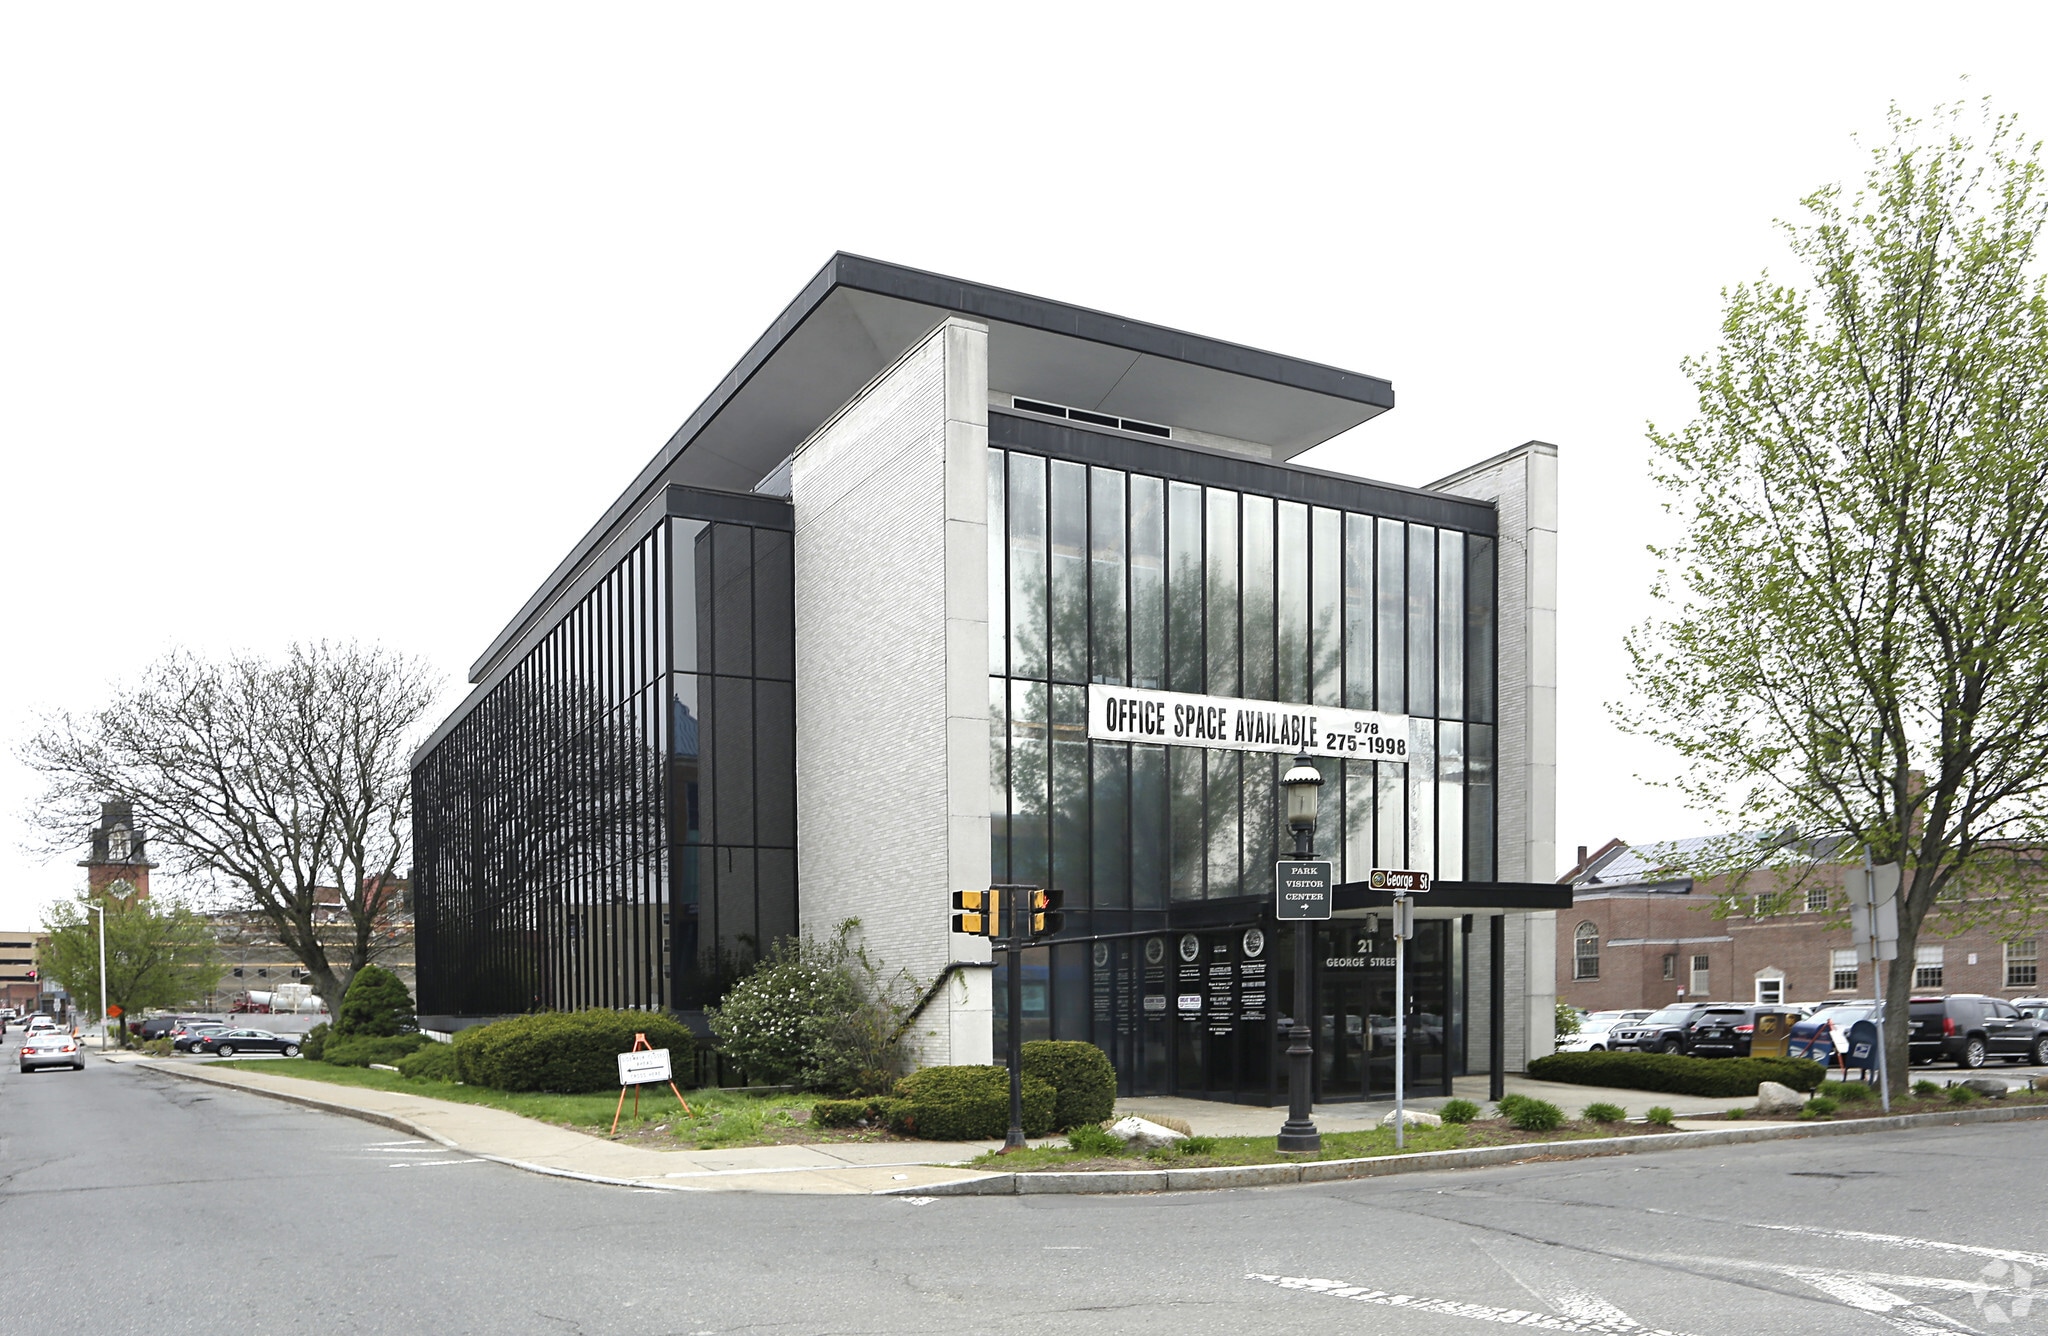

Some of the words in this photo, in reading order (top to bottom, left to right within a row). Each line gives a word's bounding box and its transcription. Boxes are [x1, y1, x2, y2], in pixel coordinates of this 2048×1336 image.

[1106, 697, 1165, 735] OFFICE
[1174, 703, 1227, 741] SPACE
[1234, 710, 1318, 748] AVAILABLE
[1354, 721, 1379, 735] 978
[1326, 732, 1407, 756] 275-1998
[1291, 867, 1318, 875] PARK
[1285, 880, 1324, 888] VISITOR
[1386, 870, 1413, 891] George
[1419, 873, 1428, 889] St
[1285, 893, 1324, 901] CENTER
[1357, 939, 1373, 953] 21
[1326, 957, 1365, 967] GEORGE
[1369, 957, 1397, 967] STREE
